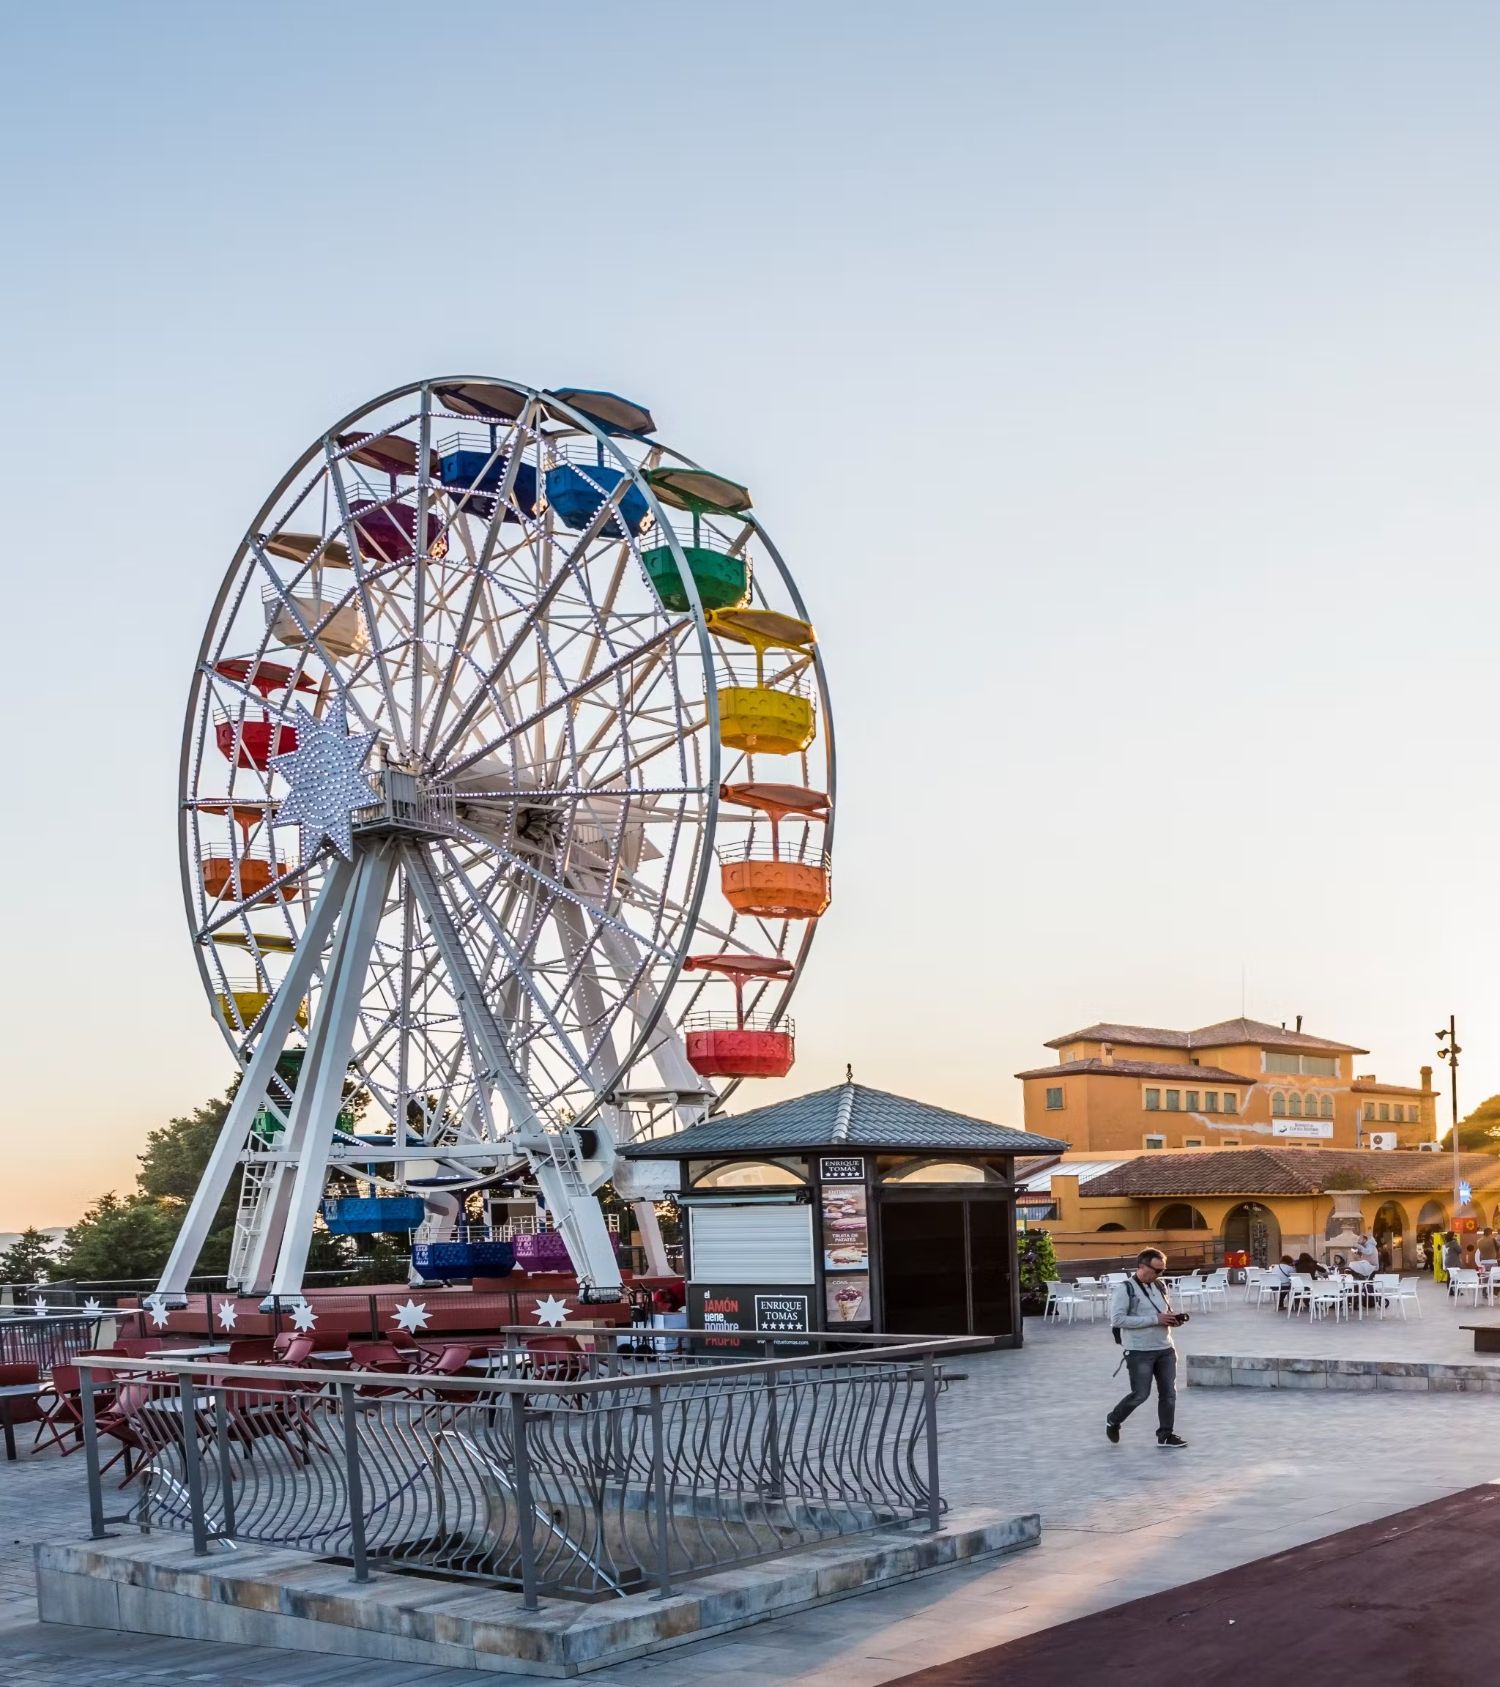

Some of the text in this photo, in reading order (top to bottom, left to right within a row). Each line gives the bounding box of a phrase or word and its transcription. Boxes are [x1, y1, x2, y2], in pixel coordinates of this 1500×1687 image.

[704, 1290, 710, 1299] el
[704, 1297, 738, 1312] JAMÓN
[761, 1301, 802, 1311] ENRIQUE
[704, 1312, 724, 1322] tiene
[765, 1312, 798, 1320] TOMAS
[704, 1320, 739, 1331] nombre
